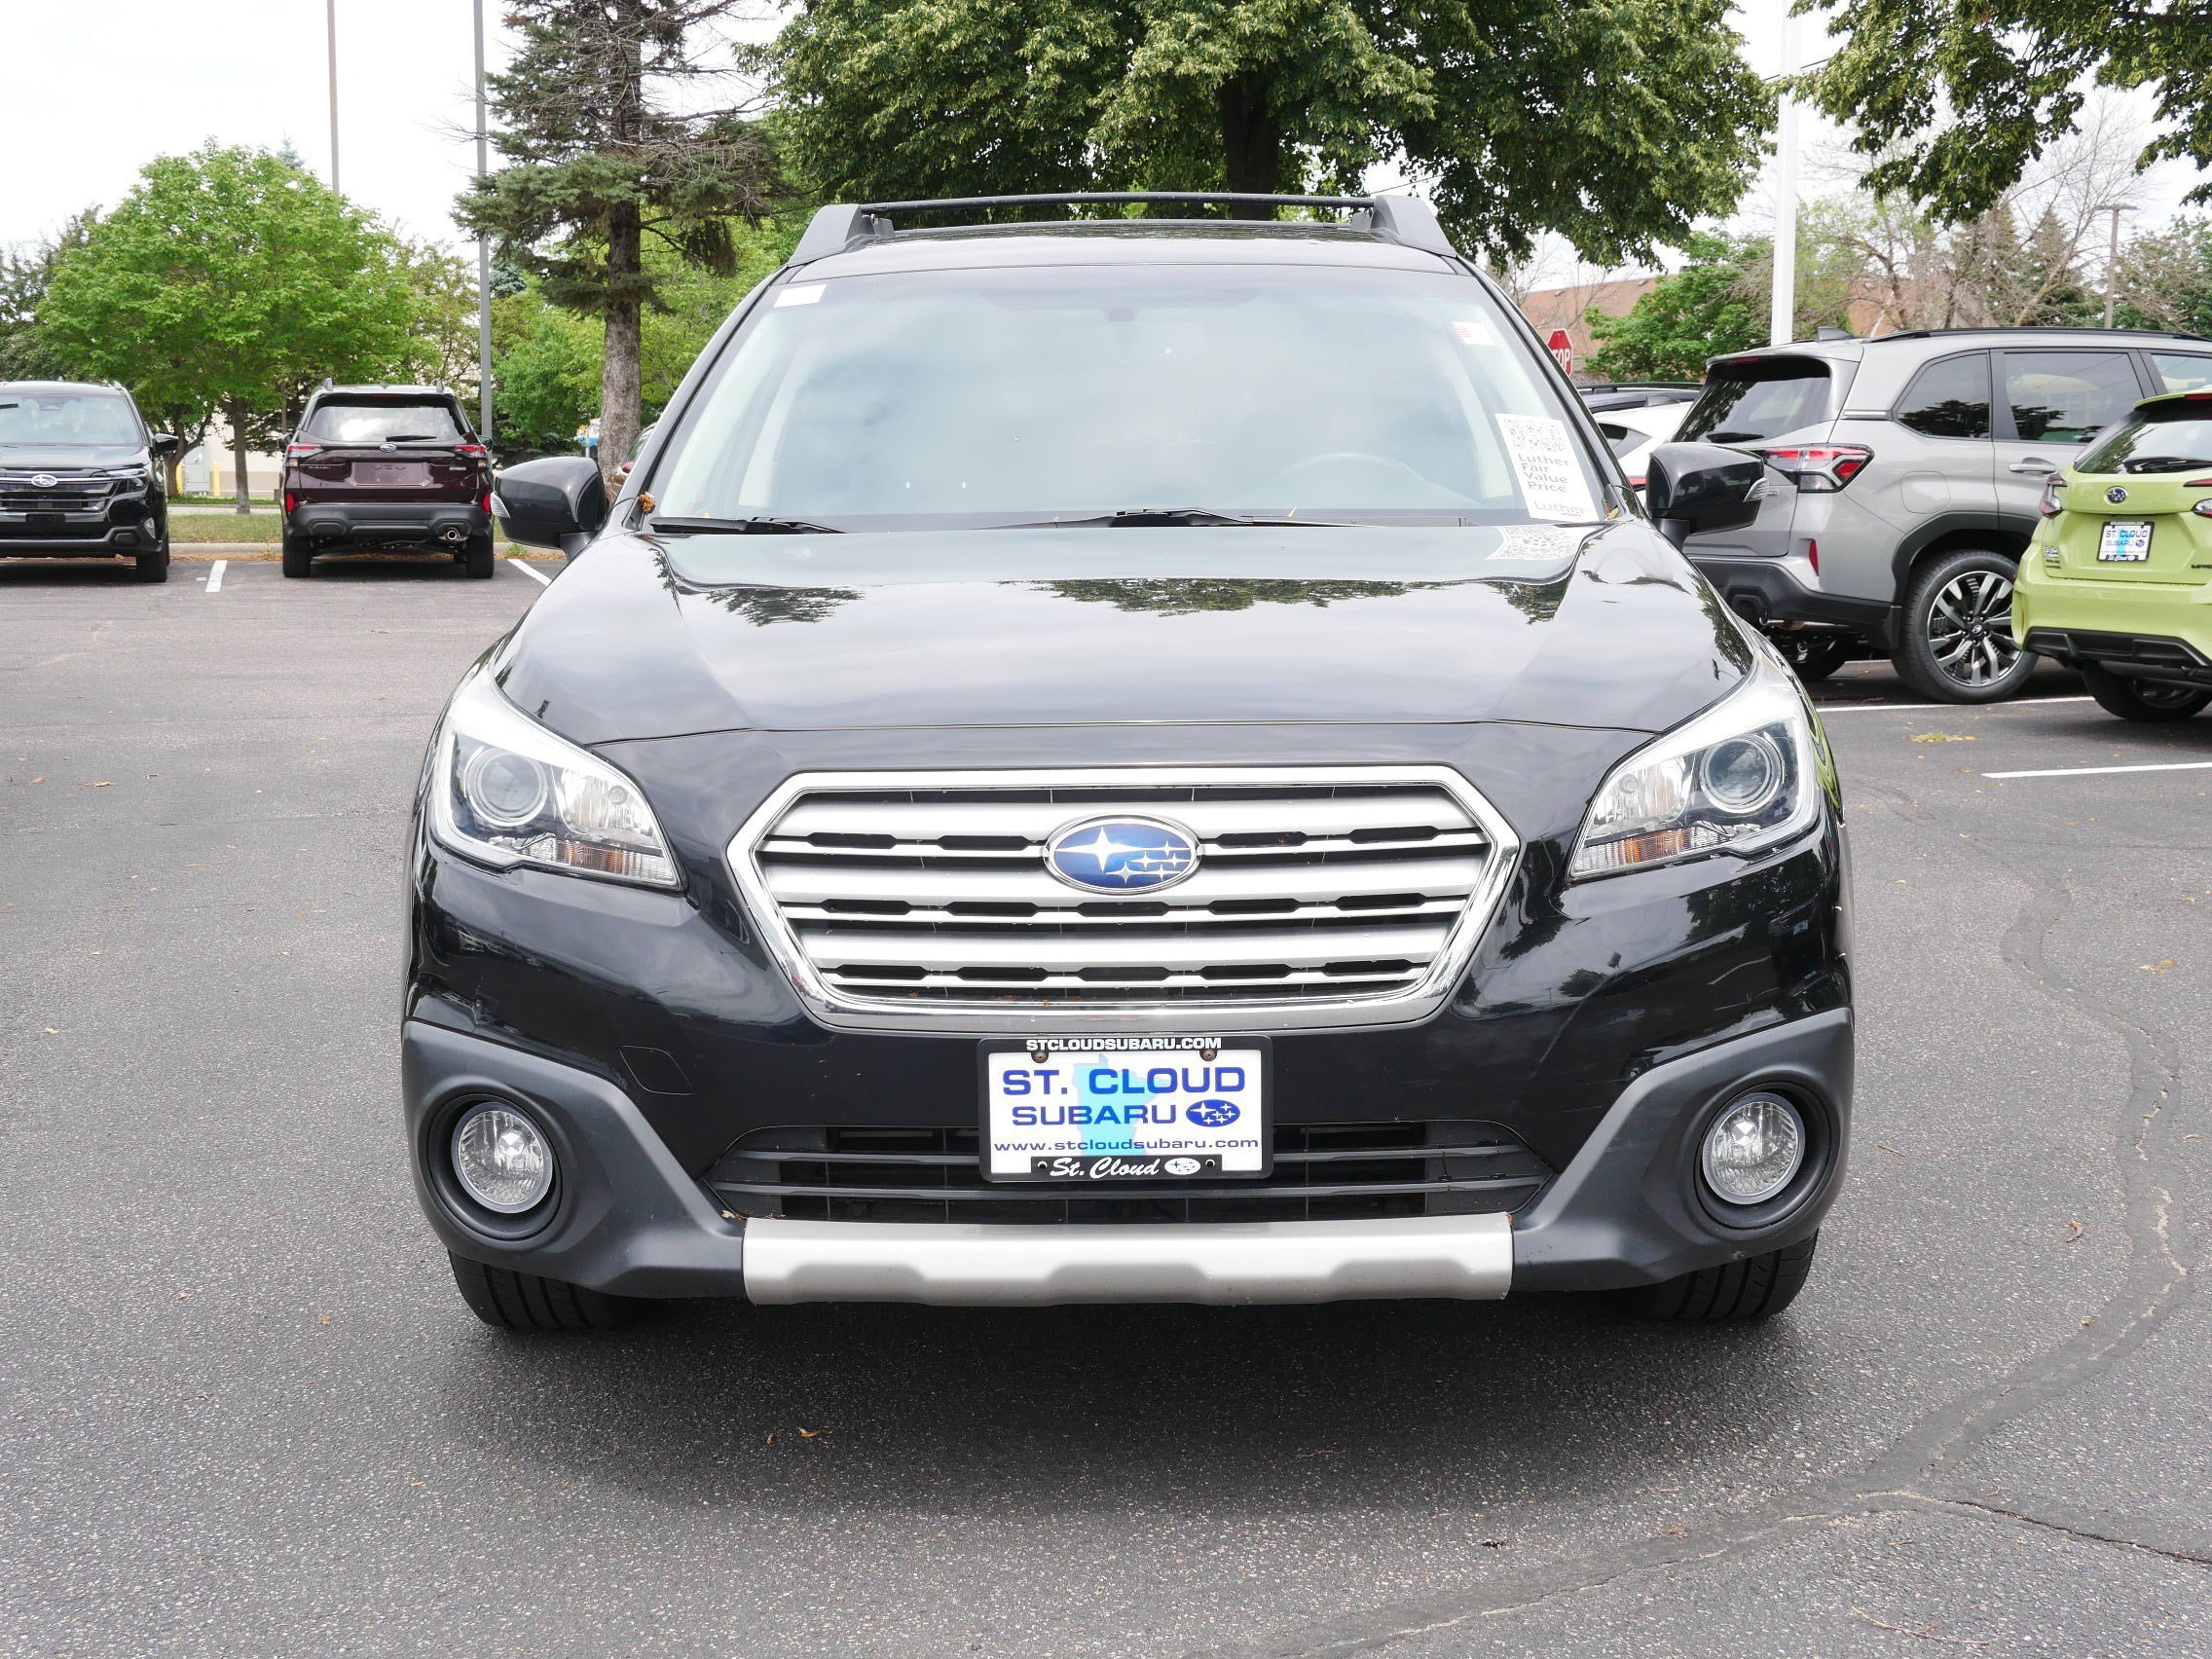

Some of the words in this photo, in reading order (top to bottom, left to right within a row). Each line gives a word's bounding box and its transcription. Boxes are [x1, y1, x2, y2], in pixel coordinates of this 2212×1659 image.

[1518, 454, 1568, 466] Luther
[1521, 462, 1548, 473] Fair
[1523, 471, 1568, 484] Value
[1528, 481, 1567, 493] Price
[1533, 500, 1585, 514] Luther
[1026, 1038, 1222, 1051] STCLOUDSUBARU.COM
[1003, 1069, 1068, 1095] ST.
[1088, 1067, 1245, 1094] CLOUD
[1012, 1105, 1176, 1126] SUBARU
[994, 1138, 1259, 1151] www.stcloudsubaru.com
[1050, 1158, 1085, 1177] St.
[1089, 1158, 1160, 1179] Cloud
